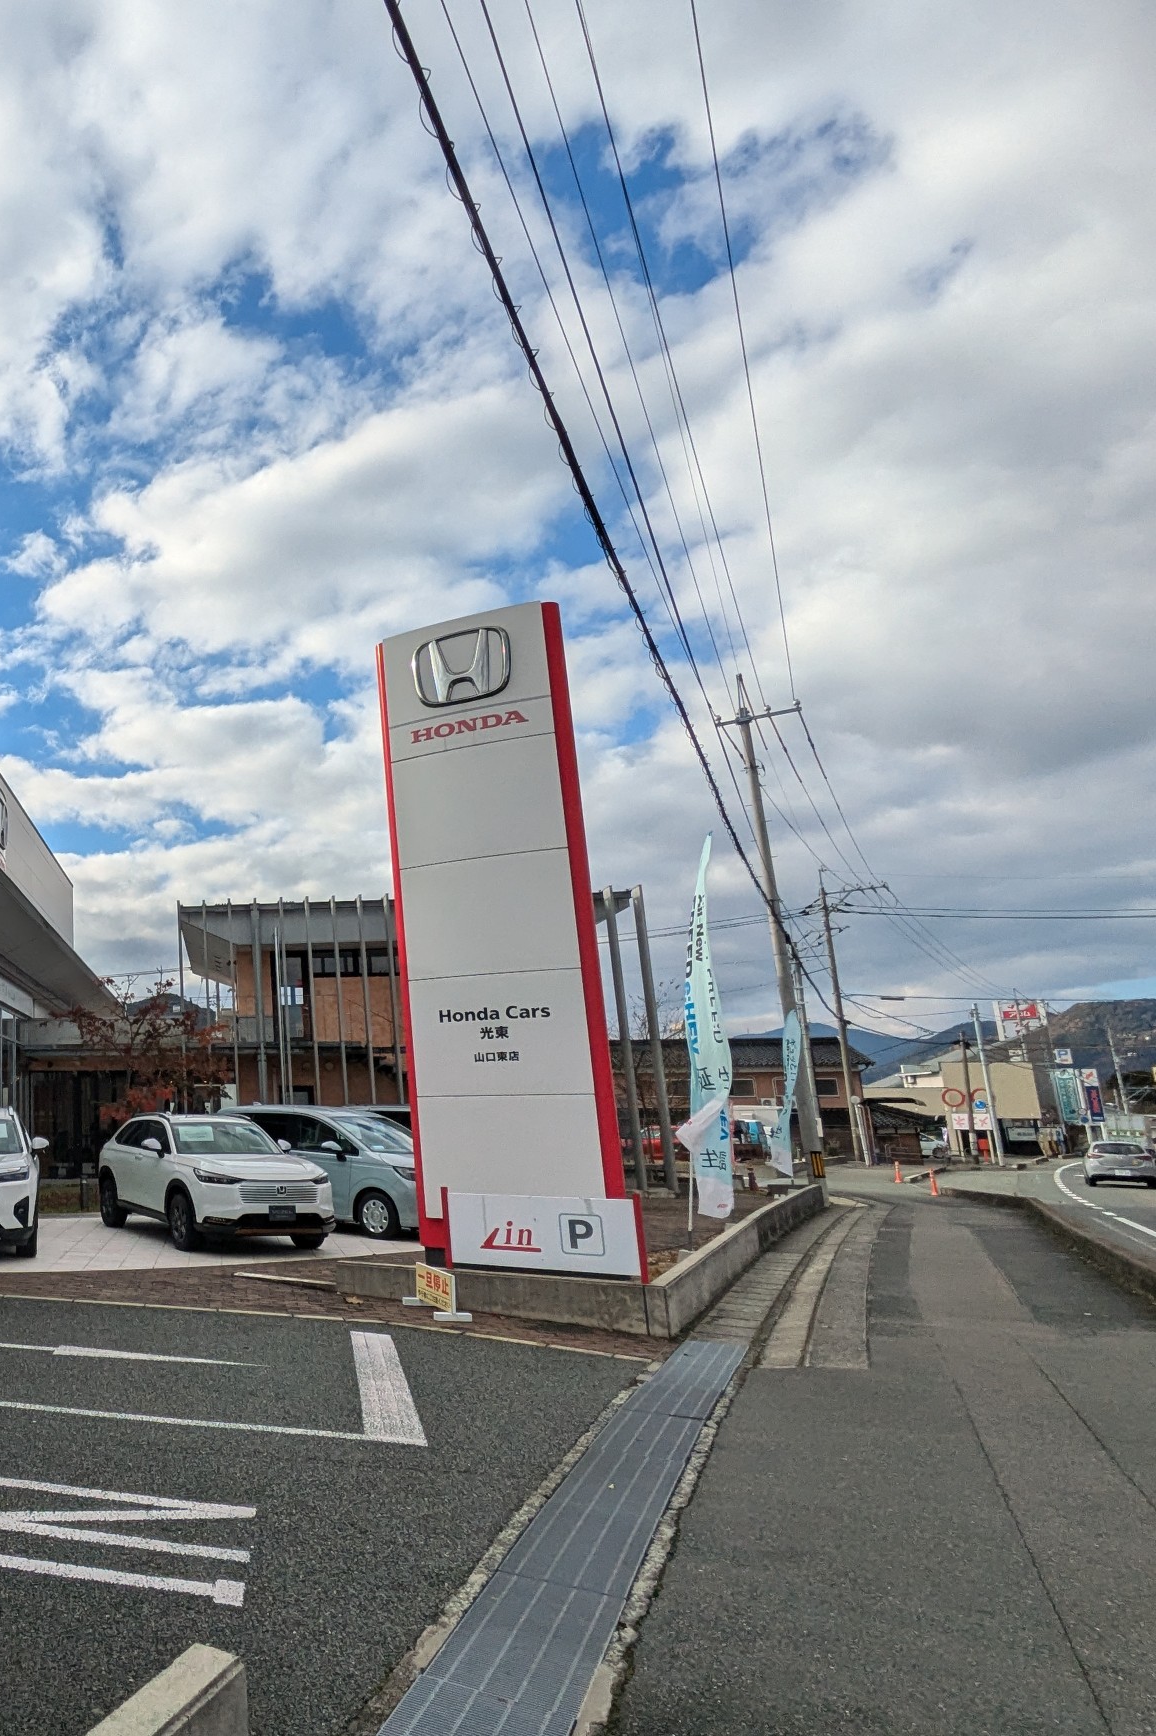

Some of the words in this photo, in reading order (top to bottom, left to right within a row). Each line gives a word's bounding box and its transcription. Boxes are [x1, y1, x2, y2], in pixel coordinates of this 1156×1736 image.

[411, 710, 529, 744] HONDA
[439, 1007, 500, 1023] Honda
[506, 1005, 551, 1019] Cars
[479, 1026, 509, 1039] 光東
[474, 1051, 520, 1063] 山口東店
[567, 1219, 594, 1249] P
[417, 1271, 450, 1296] 一旦停止
